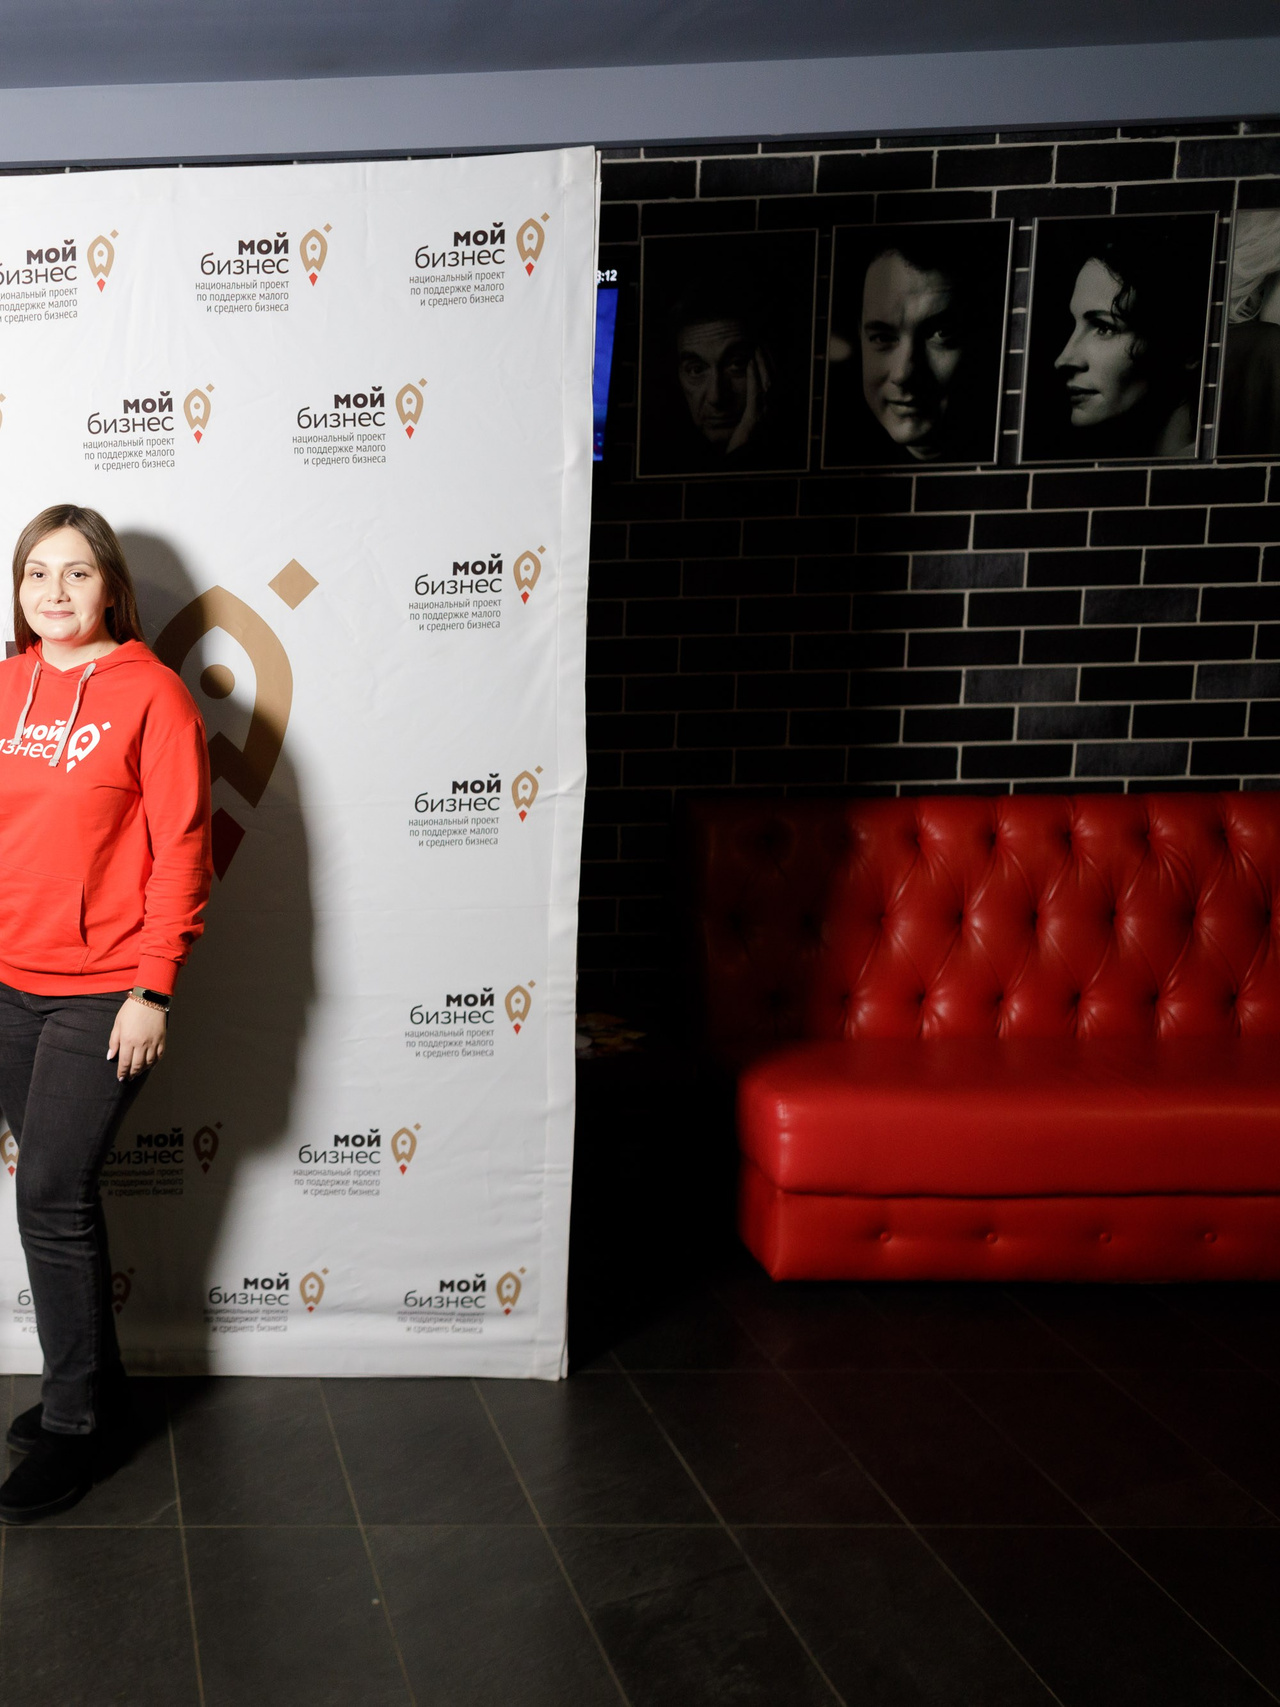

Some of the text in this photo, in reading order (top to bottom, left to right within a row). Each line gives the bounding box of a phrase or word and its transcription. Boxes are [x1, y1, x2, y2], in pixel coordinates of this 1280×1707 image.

[238, 232, 288, 255] мой
[454, 222, 505, 247] мой
[26, 239, 76, 264] мой
[415, 245, 505, 268] бизнес
[201, 252, 289, 275] бизнес
[409, 271, 505, 284] национальный проект
[424, 285, 471, 295] поддержке
[474, 283, 504, 292] малого
[428, 296, 466, 307] среднего
[470, 294, 504, 303] бизнеса
[123, 391, 173, 414] мой
[334, 386, 384, 409] мой
[88, 412, 174, 434] бизнес
[297, 407, 385, 428] бизнес
[293, 433, 386, 444] национальный проект
[307, 446, 353, 455] поддержке
[356, 444, 386, 452] малого
[312, 456, 349, 466] среднего
[353, 454, 386, 463] бизнеса
[452, 553, 503, 576] мой
[415, 574, 502, 595] бизнес
[409, 599, 502, 610] национальный проект
[423, 611, 469, 621] поддержке
[472, 610, 501, 618] малого
[427, 622, 464, 632] среднего
[467, 620, 500, 629] бизнеса
[452, 773, 501, 794] мой
[415, 792, 500, 812] бизнес
[446, 987, 494, 1007] мой
[410, 1005, 494, 1024] бизнес
[137, 1129, 182, 1148] мой
[334, 1129, 381, 1147] мой
[299, 1144, 381, 1164] бизнес
[307, 1179, 350, 1187] поддержке
[354, 1170, 380, 1178] проект
[349, 1187, 379, 1195] бизнеса
[244, 1271, 288, 1290] мой
[440, 1274, 484, 1293] мой
[209, 1288, 289, 1306] бизнес
[405, 1291, 485, 1309] бизнес
